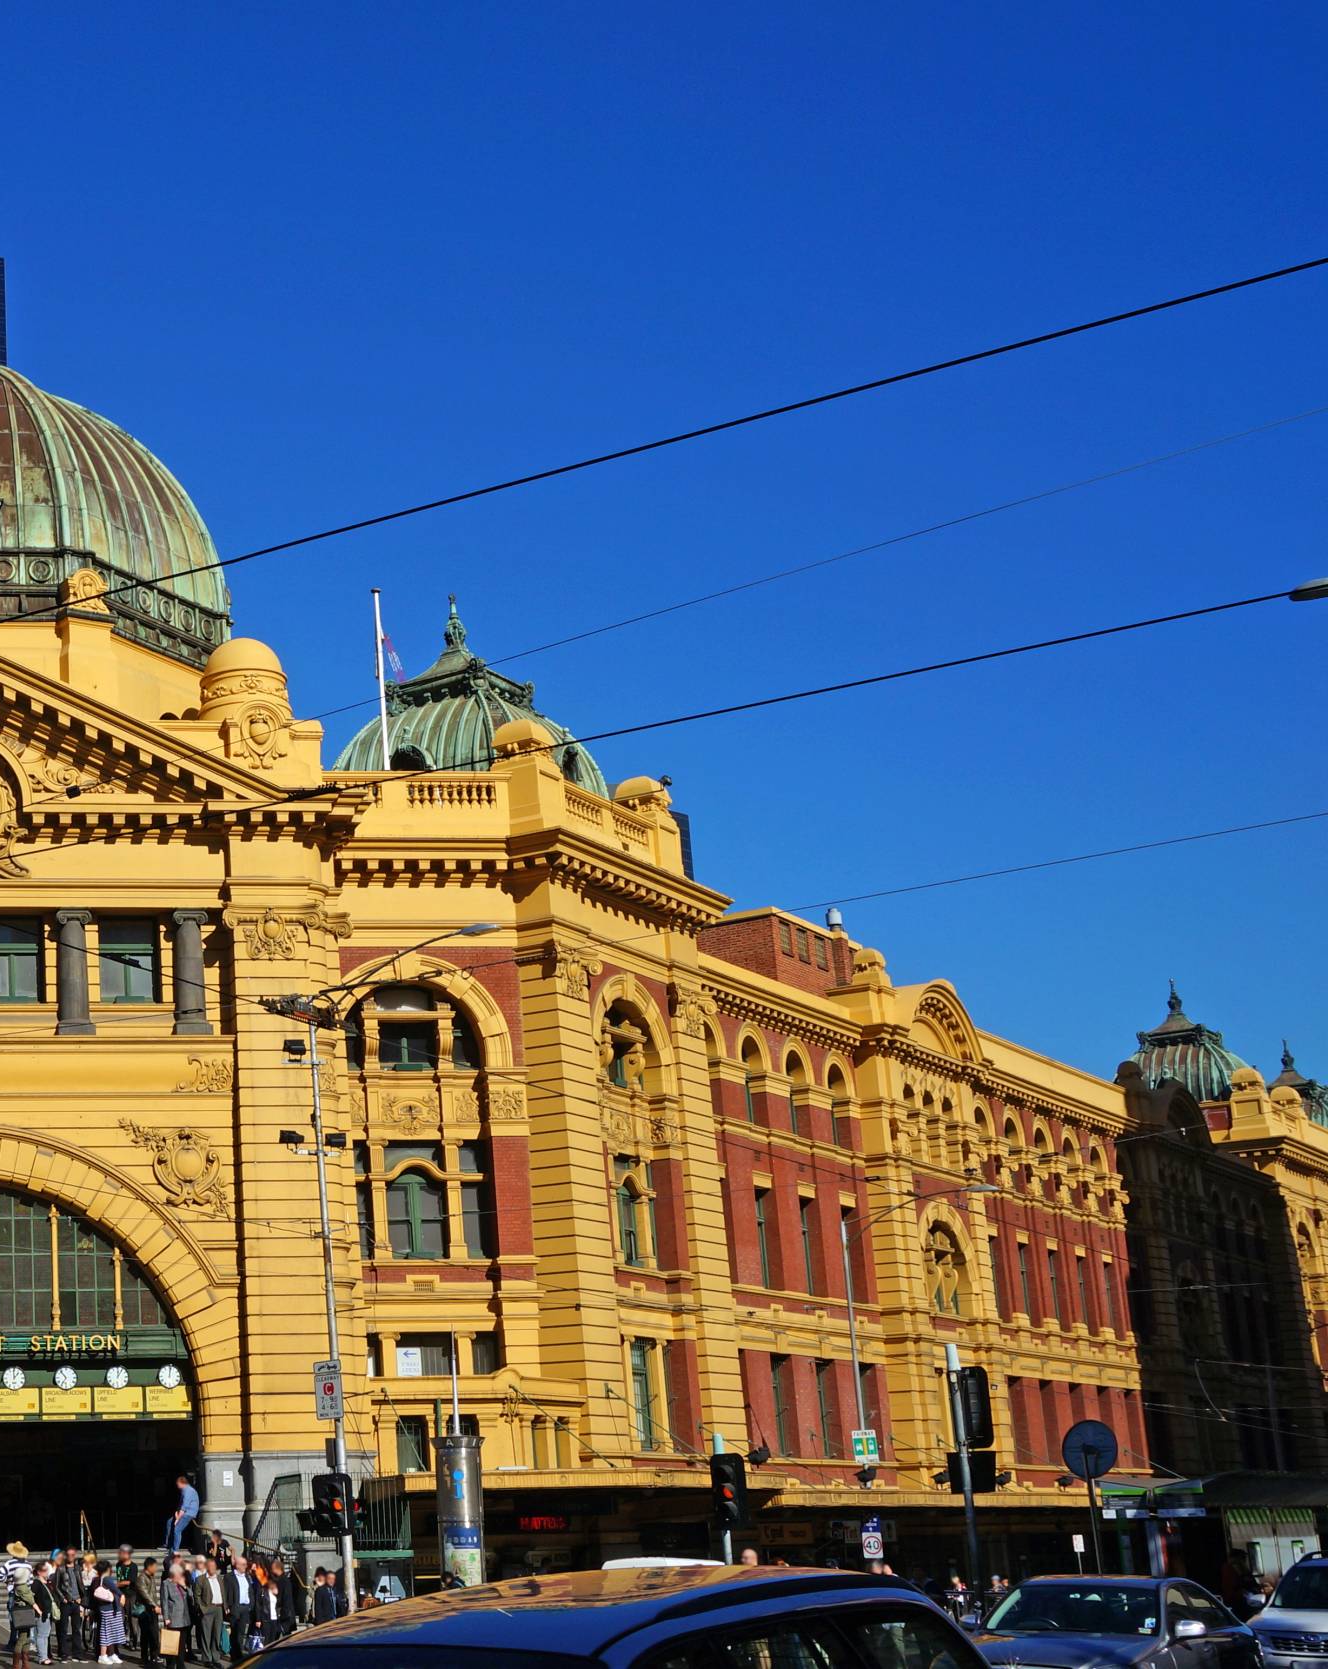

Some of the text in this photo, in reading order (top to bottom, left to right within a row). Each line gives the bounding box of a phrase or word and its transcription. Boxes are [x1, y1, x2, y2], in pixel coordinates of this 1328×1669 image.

[31, 1334, 121, 1352] STATION
[325, 1383, 332, 1395] C
[866, 1540, 879, 1550] 40
